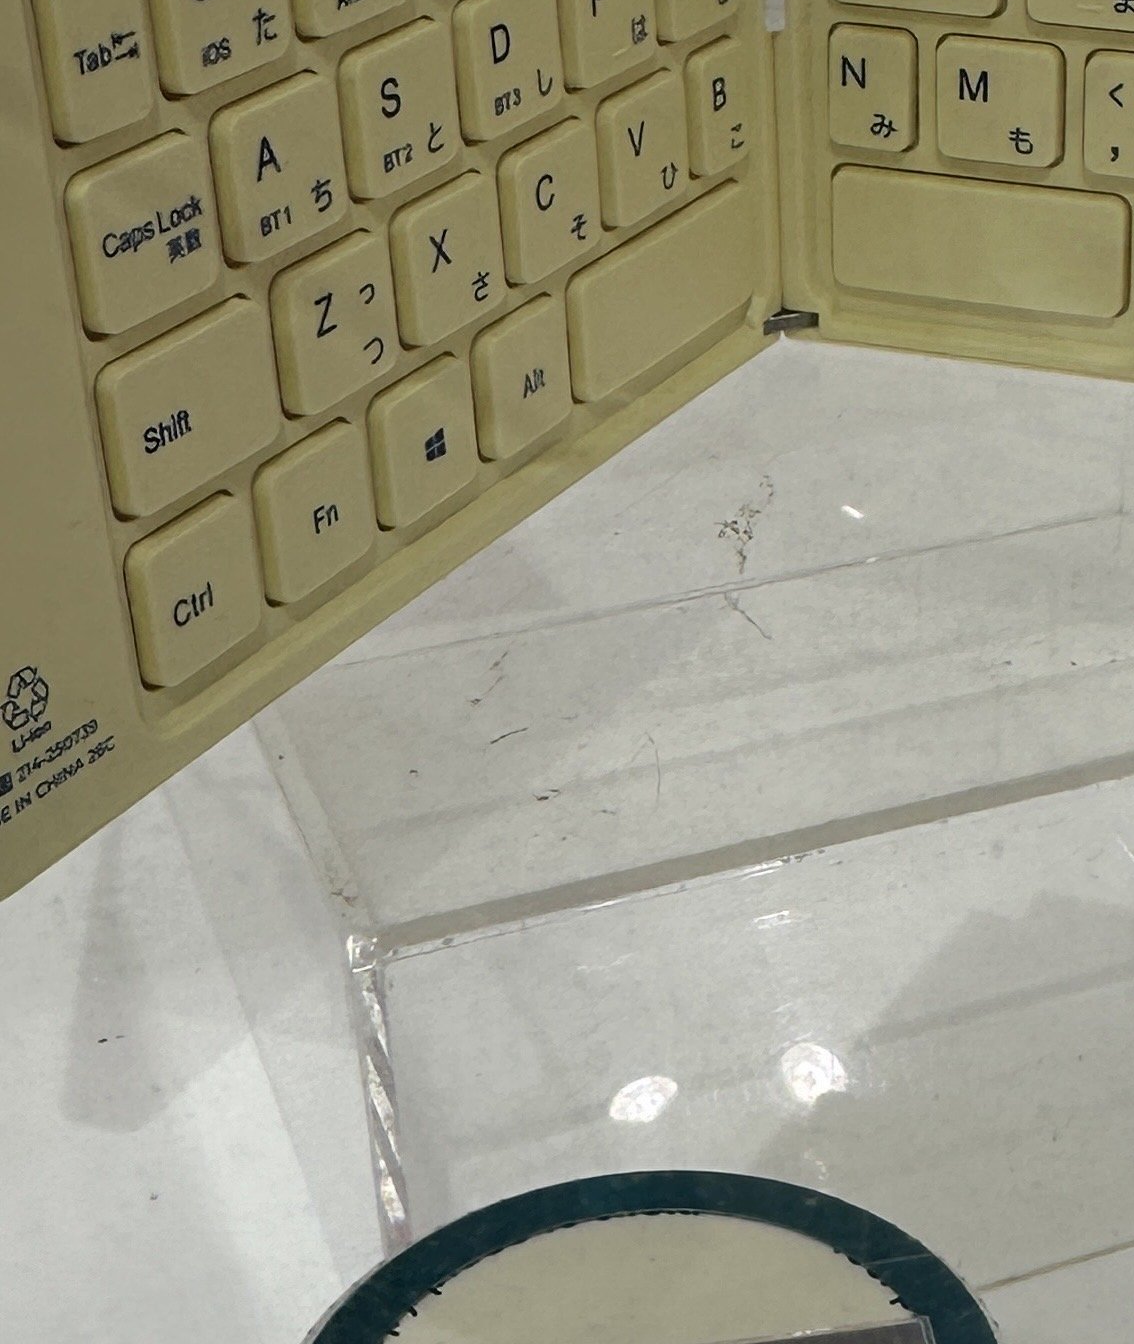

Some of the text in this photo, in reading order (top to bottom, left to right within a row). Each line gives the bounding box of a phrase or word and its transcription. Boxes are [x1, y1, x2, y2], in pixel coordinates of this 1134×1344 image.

[251, 7, 278, 46] た
[489, 23, 511, 65] D
[73, 42, 113, 76] Tab
[841, 54, 866, 90] N
[380, 77, 402, 119] S
[536, 68, 553, 97] し
[711, 76, 727, 113] B
[958, 67, 989, 103] M
[627, 120, 645, 158] V
[869, 113, 898, 139] み
[1008, 126, 1034, 155] も
[256, 135, 282, 183] A
[383, 122, 445, 174] BT2 と
[535, 173, 556, 212] C
[660, 161, 679, 191] ひ
[102, 195, 203, 258] Caps Lock
[260, 178, 333, 238] BT1 ち
[428, 228, 453, 274] X
[471, 271, 490, 303] さ
[313, 291, 338, 339] Z
[362, 336, 384, 365] つ
[142, 409, 193, 455] Shift
[313, 504, 339, 535] Fn
[173, 581, 214, 628] Ctrl
[15, 791, 33, 816] IN
